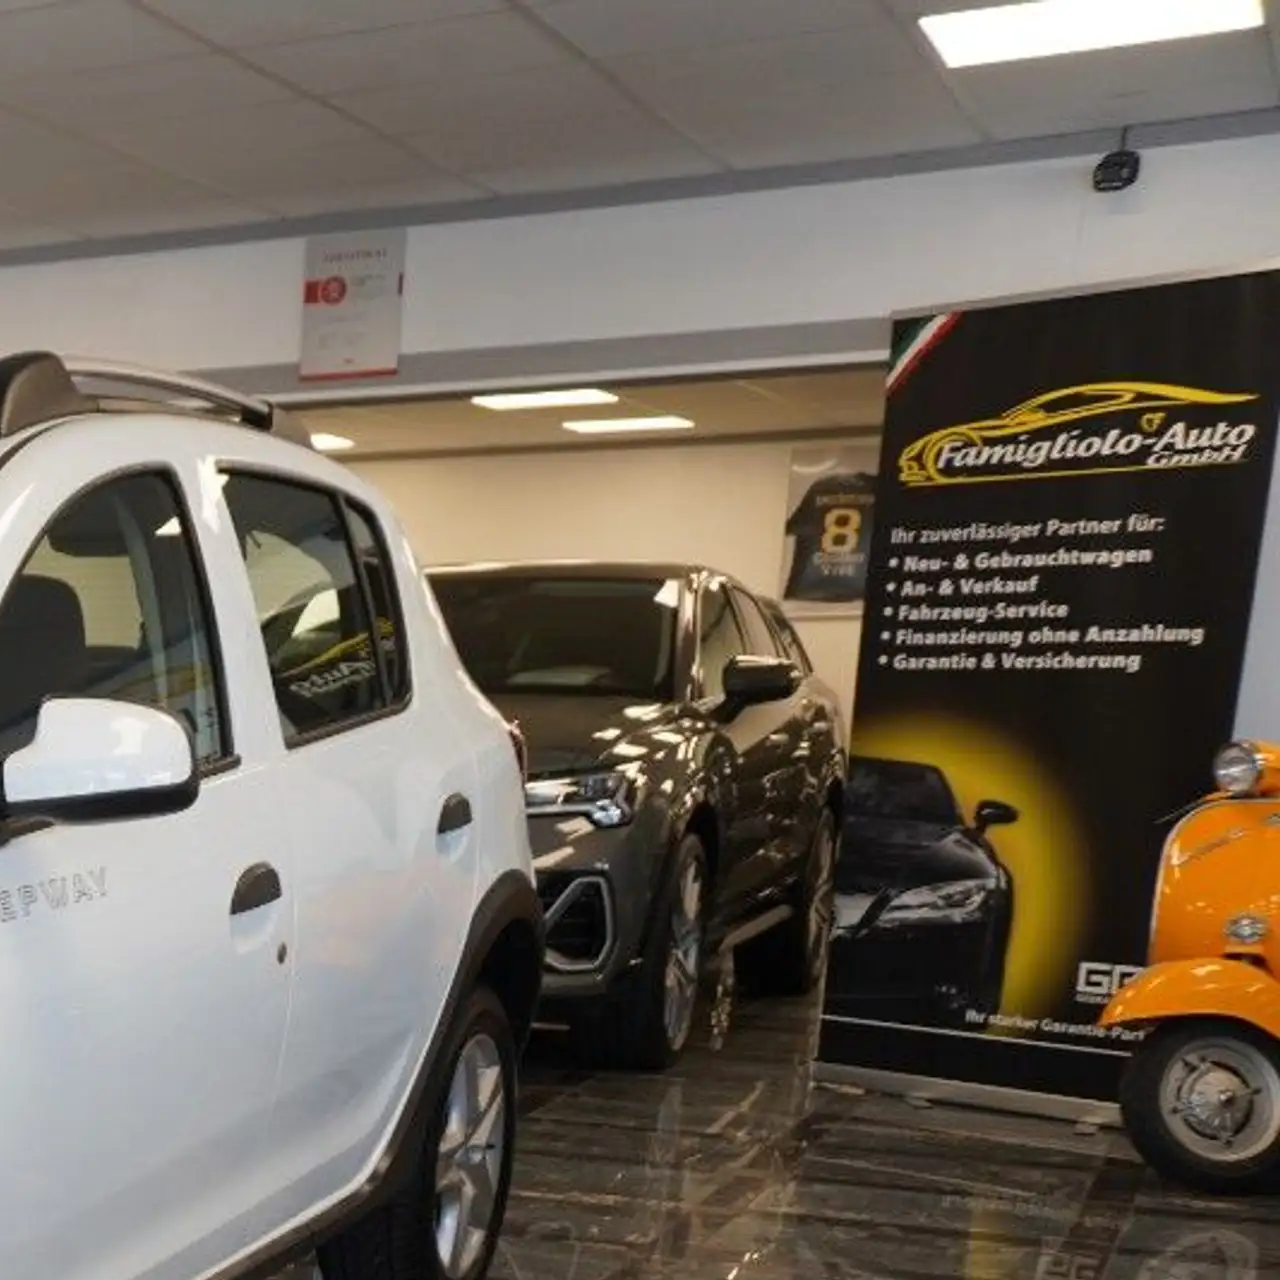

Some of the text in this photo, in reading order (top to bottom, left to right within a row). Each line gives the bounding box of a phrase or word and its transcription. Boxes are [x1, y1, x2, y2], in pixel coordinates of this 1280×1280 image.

[937, 420, 1257, 470] Famigliolo-Auto
[1145, 444, 1248, 467] GmbH
[821, 508, 861, 553] 8
[890, 513, 1166, 544] Ihr zuverlässiger Partner für:
[903, 547, 1154, 572] Neu- & Gebrauchtwagen
[900, 575, 1040, 597] An- & Verkauf
[897, 601, 1069, 623] Fahrzeug-Service
[895, 624, 1205, 648] Finanzierung ohne Anzahlung
[892, 651, 1141, 673] Garantie & Versicherung
